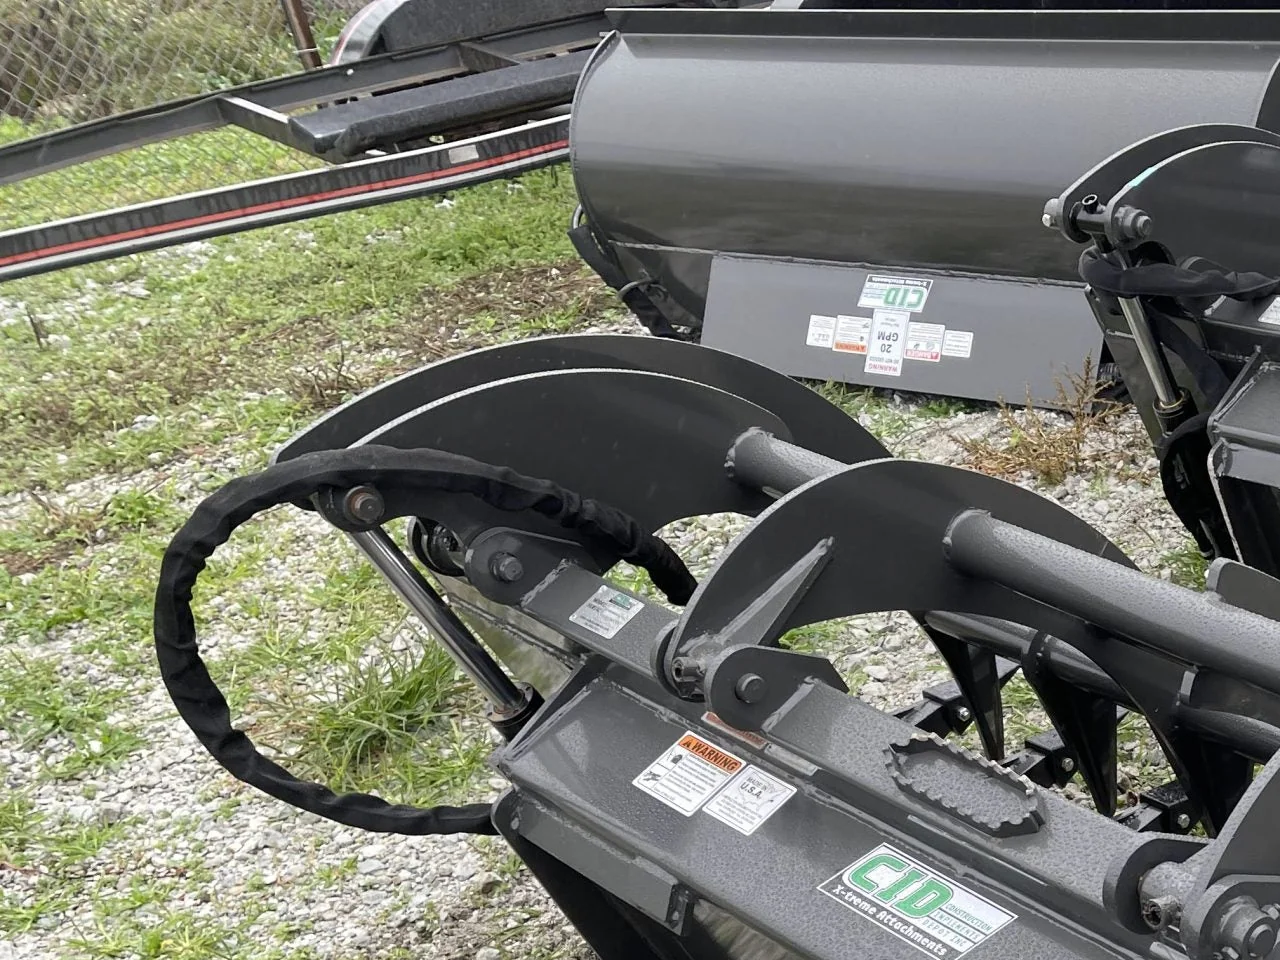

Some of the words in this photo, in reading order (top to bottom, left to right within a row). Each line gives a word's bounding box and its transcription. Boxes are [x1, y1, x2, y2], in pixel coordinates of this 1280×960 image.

[884, 288, 925, 308] CID
[877, 331, 898, 342] GPM
[881, 343, 892, 353] 20
[693, 742, 738, 772] WARNING
[848, 854, 954, 919] CID
[832, 884, 879, 916] X-treme
[876, 910, 948, 956] Attachments
[945, 902, 993, 932] CONSTRUCTION
